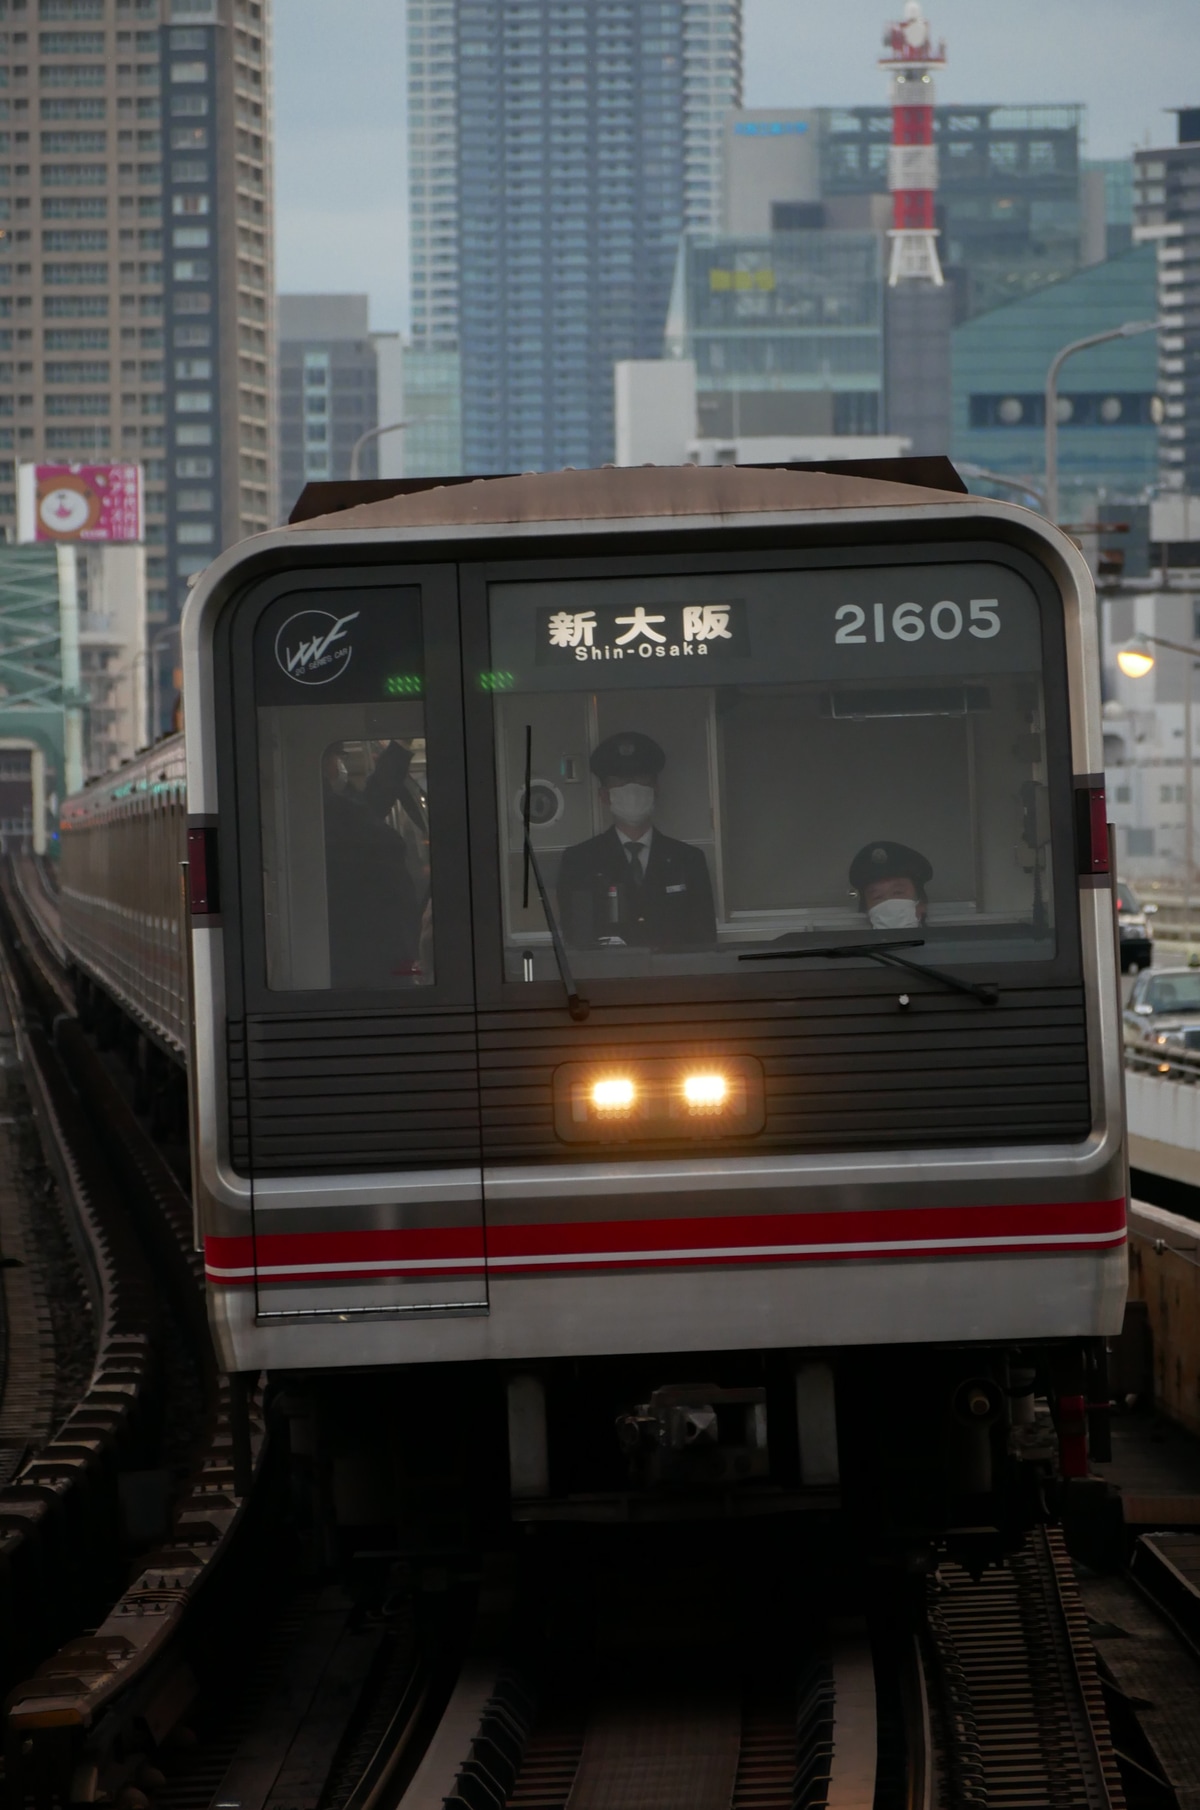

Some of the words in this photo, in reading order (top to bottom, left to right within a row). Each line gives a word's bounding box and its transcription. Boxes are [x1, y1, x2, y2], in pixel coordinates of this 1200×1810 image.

[548, 605, 733, 647] 新大阪
[835, 599, 1001, 644] 21605
[334, 648, 349, 660] CAR
[575, 642, 708, 661] Shin-Osaka
